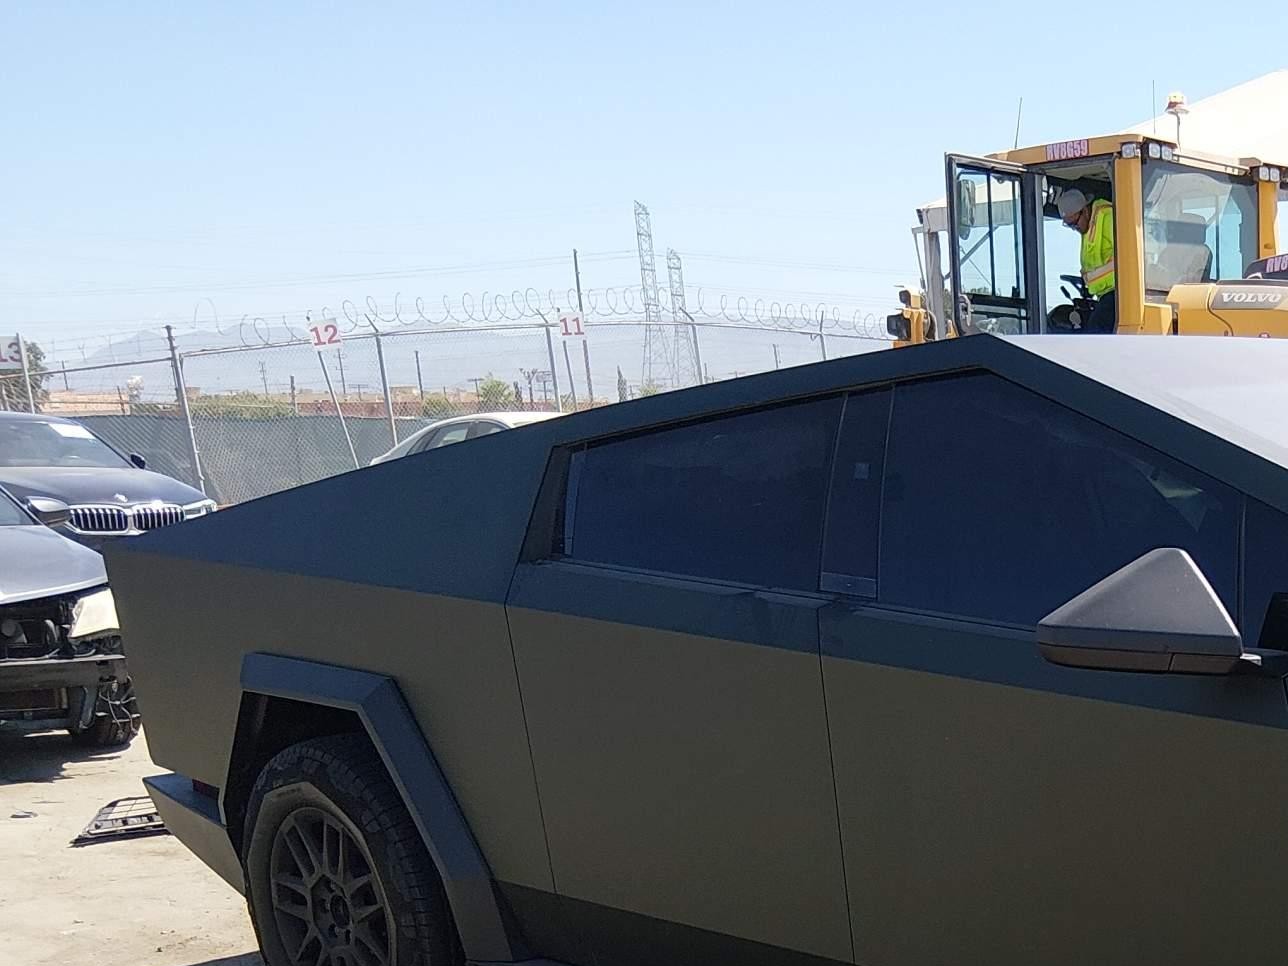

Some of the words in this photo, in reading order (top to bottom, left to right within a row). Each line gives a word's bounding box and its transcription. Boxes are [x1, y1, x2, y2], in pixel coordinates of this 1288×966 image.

[1221, 292, 1282, 303] VOLVO
[310, 324, 341, 346] 12
[560, 316, 585, 336] 11
